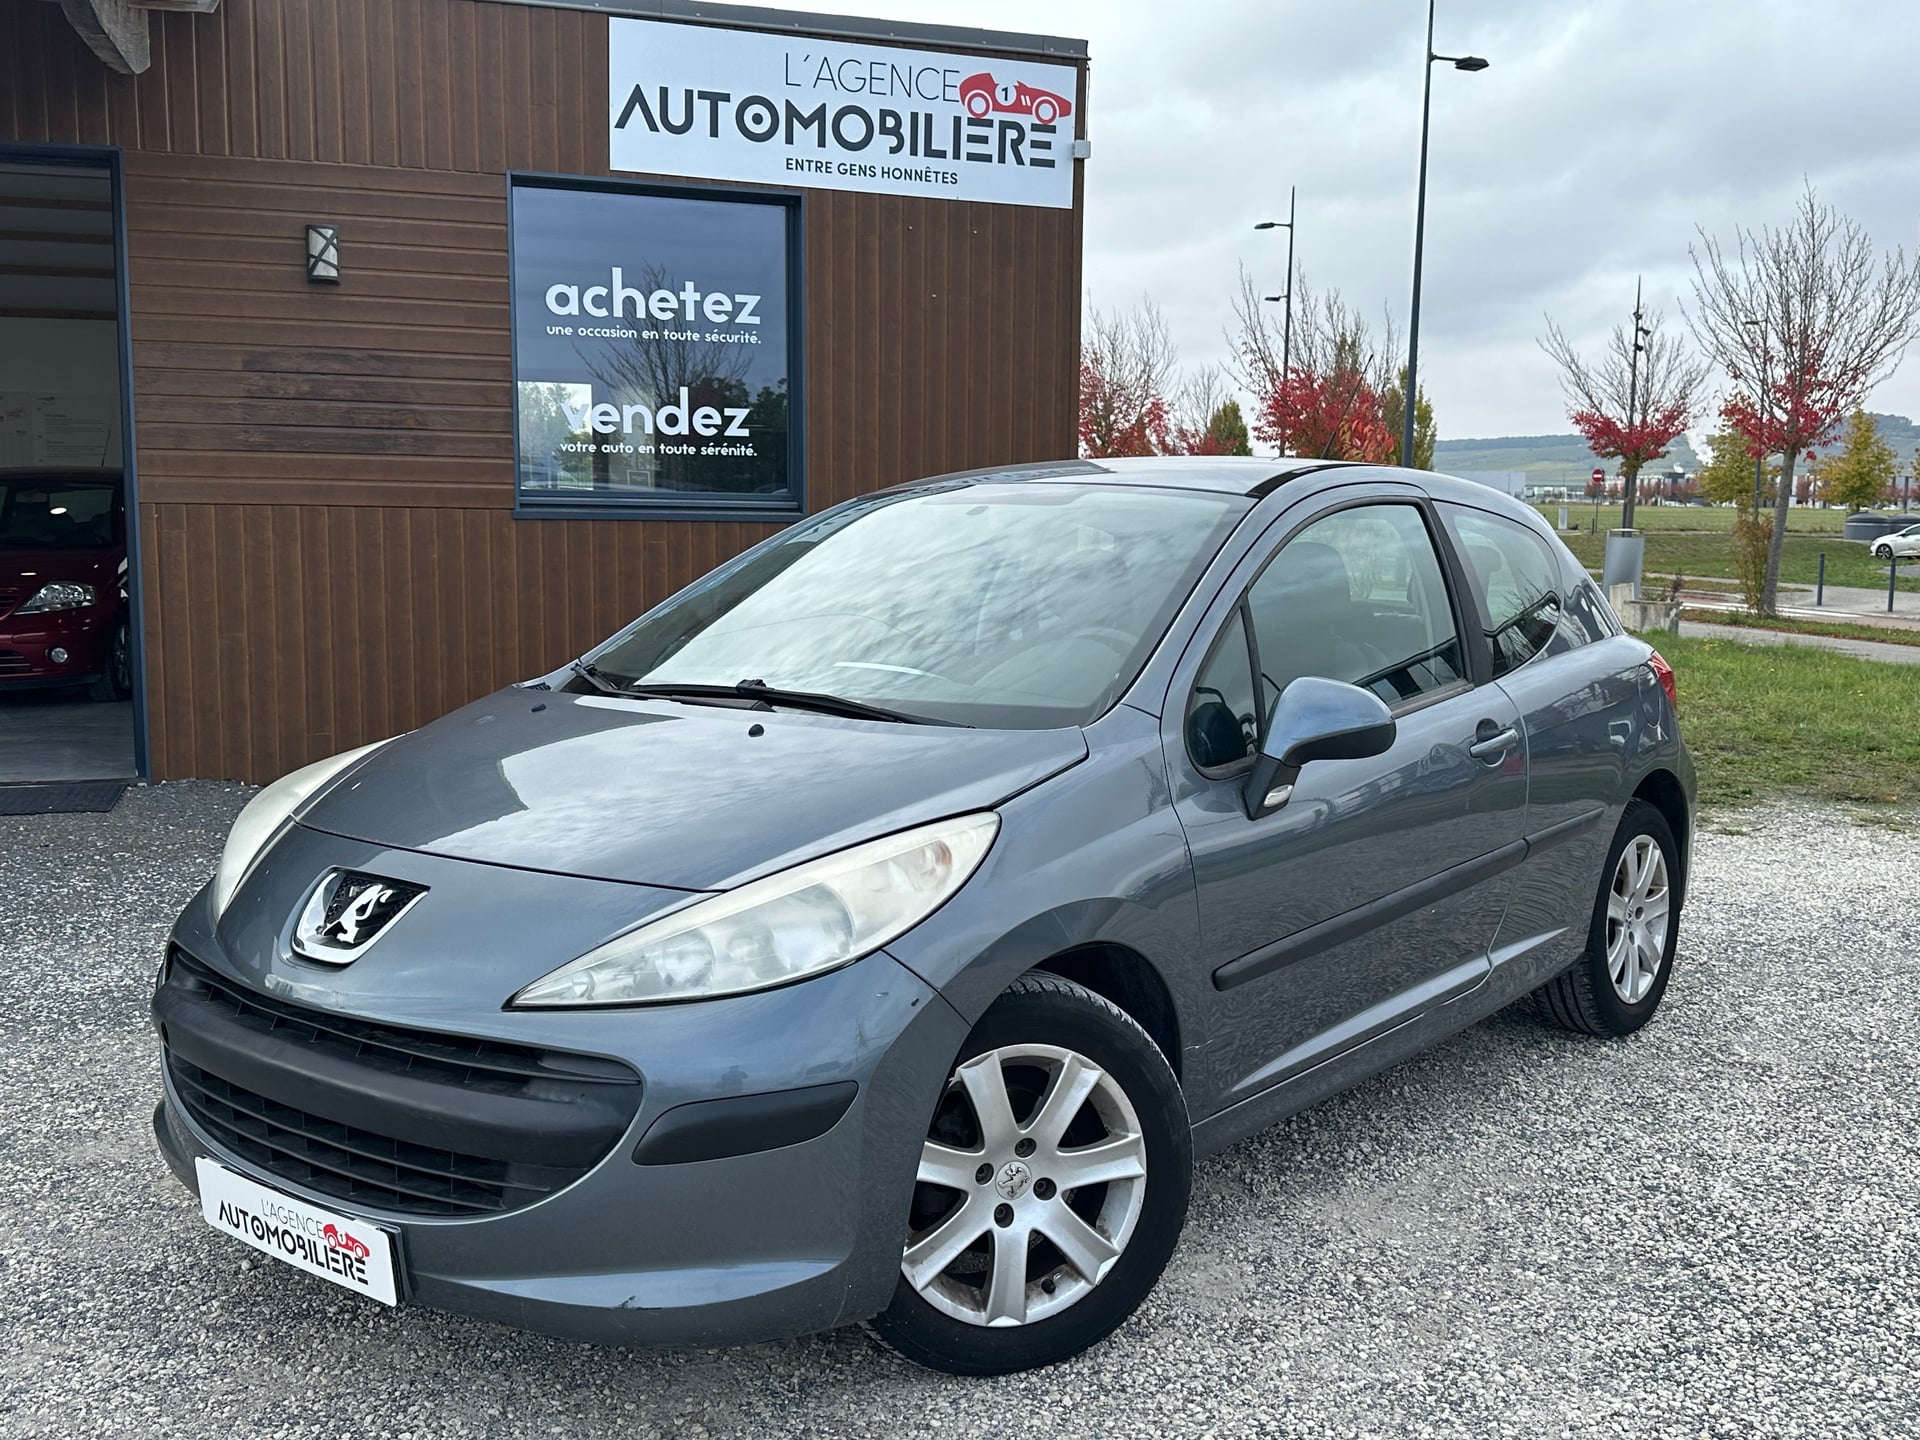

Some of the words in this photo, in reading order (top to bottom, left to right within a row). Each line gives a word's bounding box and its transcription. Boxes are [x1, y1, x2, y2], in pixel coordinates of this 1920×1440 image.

[784, 52, 960, 102] L'AGENCE
[1001, 86, 1009, 101] 1
[785, 157, 833, 174] ENTRE
[837, 163, 877, 179] GENS
[881, 165, 958, 185] HONNÊTES
[545, 266, 761, 325] achetez
[547, 325, 573, 336] une
[577, 325, 637, 339] occasion
[642, 330, 659, 340] en
[663, 329, 700, 342] toute
[705, 329, 761, 345] sécurité.
[561, 386, 750, 437] vendez
[560, 442, 597, 453] votre
[601, 443, 634, 454] auto
[638, 445, 655, 455] en
[659, 443, 696, 455] toute
[700, 443, 757, 457] sérénité.
[261, 1198, 324, 1240] L'AGENCE
